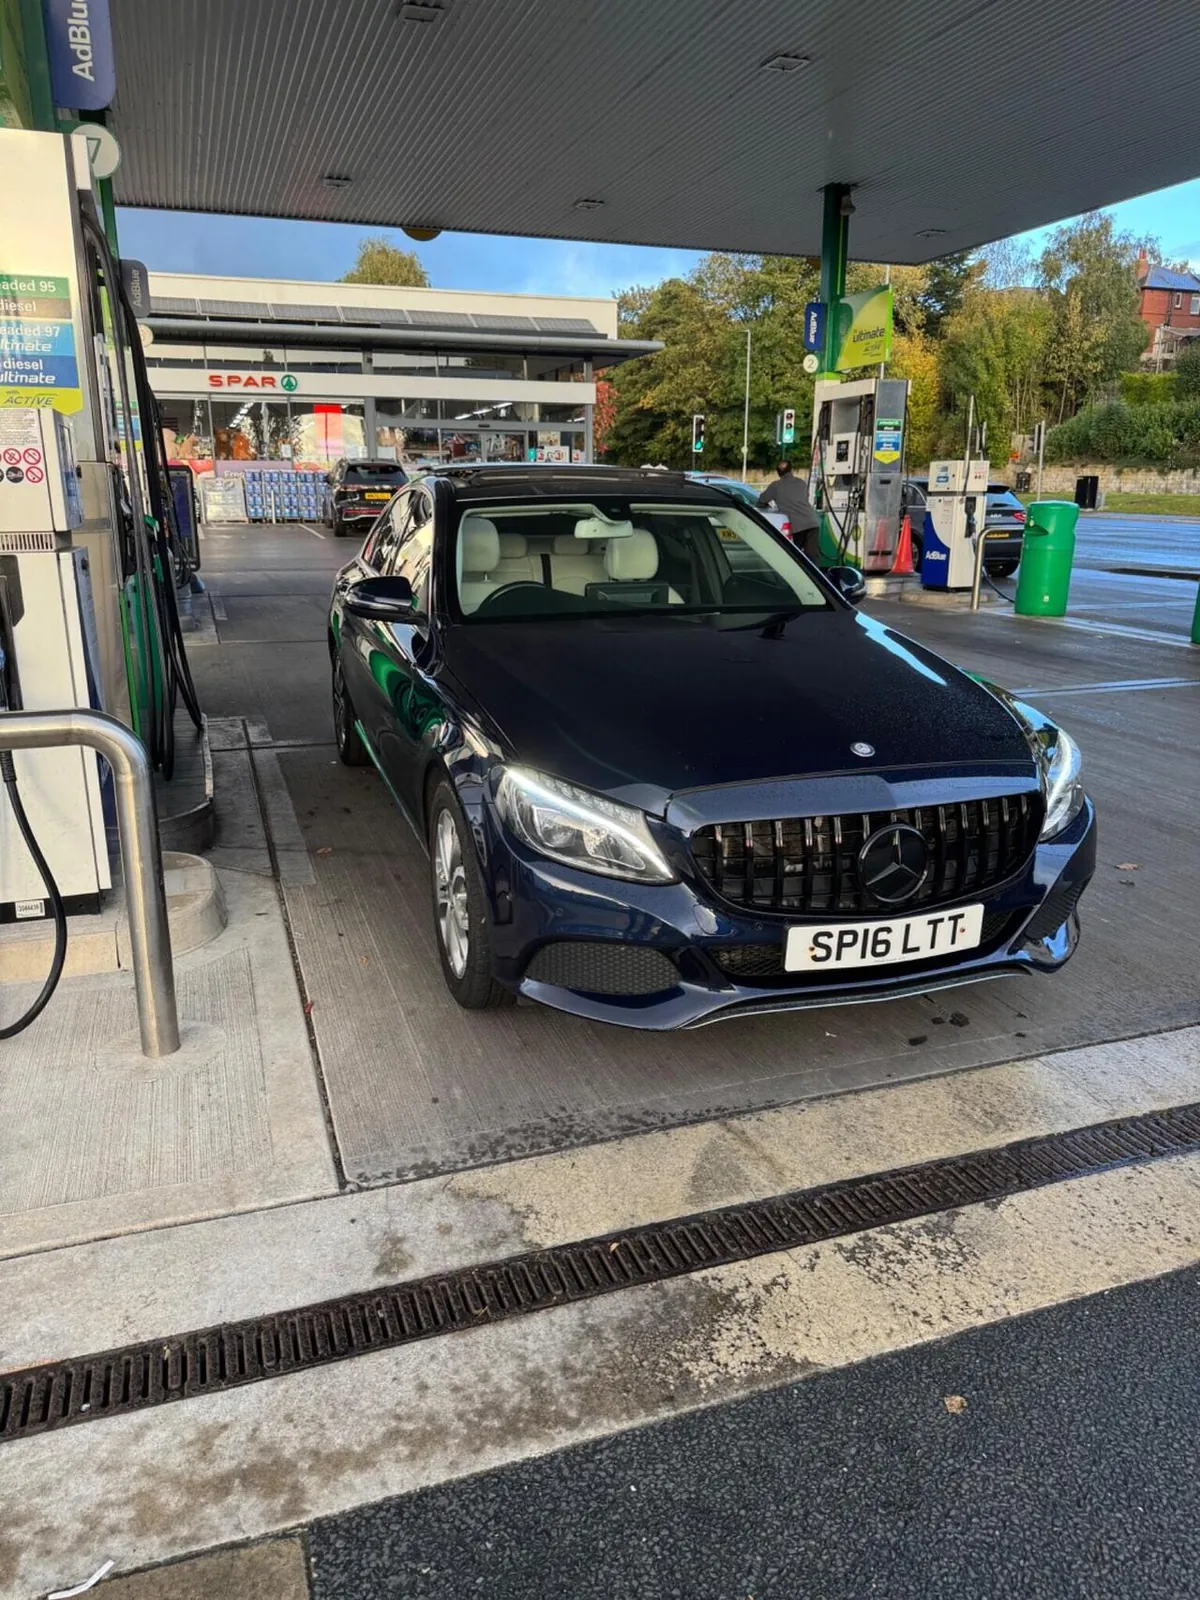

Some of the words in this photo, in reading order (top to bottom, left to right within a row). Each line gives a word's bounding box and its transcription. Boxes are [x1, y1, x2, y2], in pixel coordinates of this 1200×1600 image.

[67, 0, 95, 82] AdBlu
[0, 279, 36, 291] aded
[39, 280, 56, 292] 95
[45, 325, 60, 337] 97
[3, 357, 43, 370] diesel
[807, 359, 815, 369] 2
[208, 375, 277, 388] SPAR
[811, 927, 893, 962] SP16
[902, 913, 965, 954] LTT
